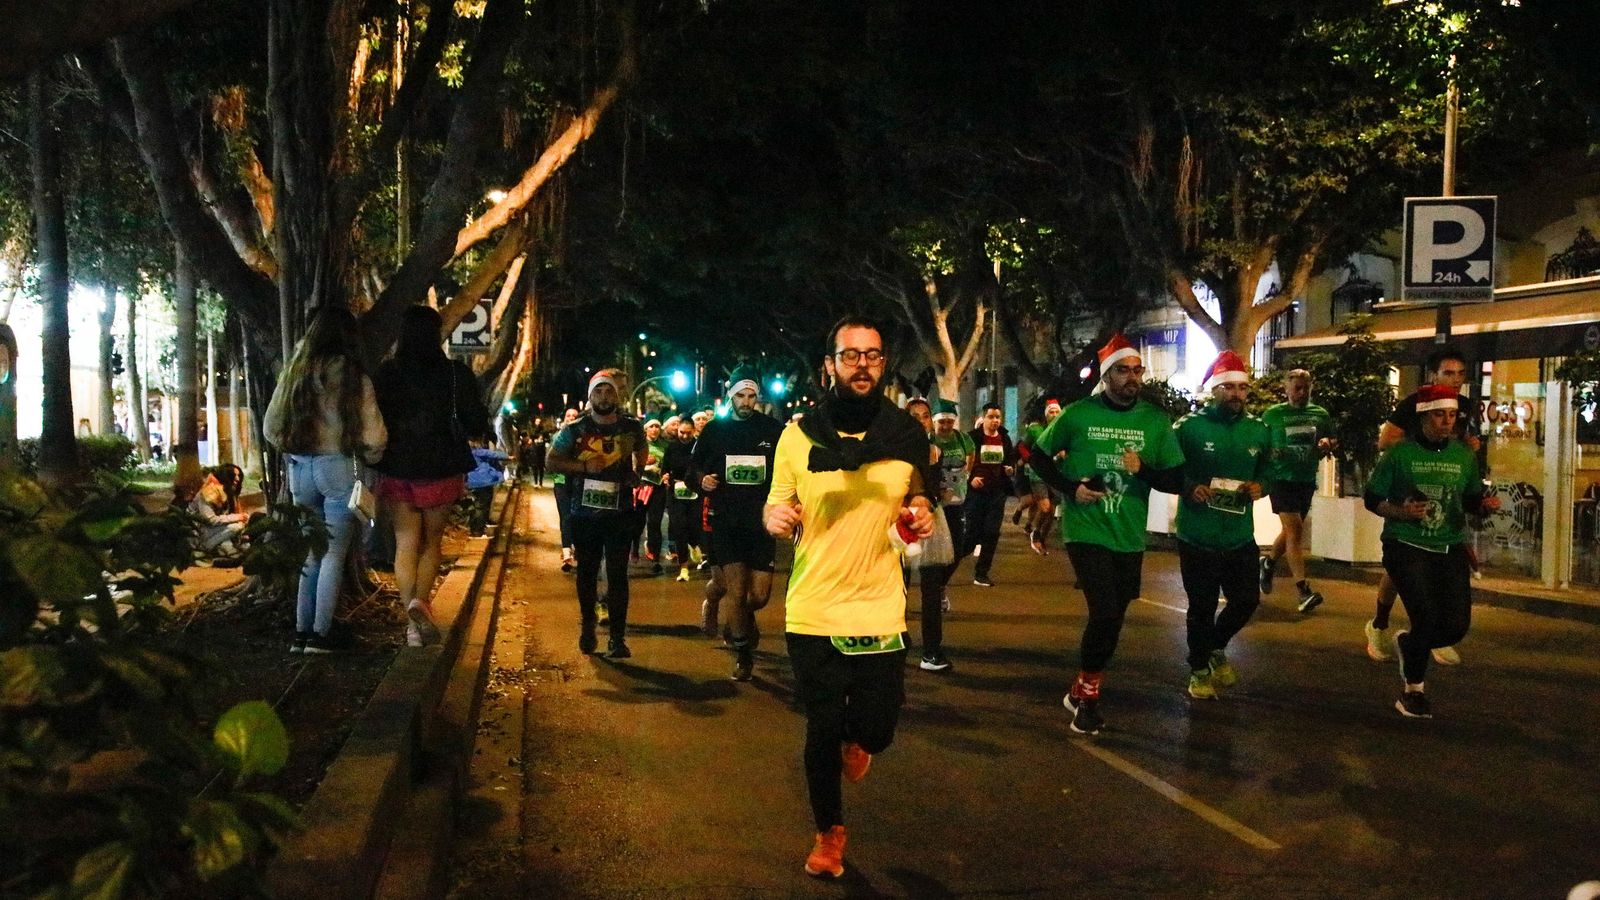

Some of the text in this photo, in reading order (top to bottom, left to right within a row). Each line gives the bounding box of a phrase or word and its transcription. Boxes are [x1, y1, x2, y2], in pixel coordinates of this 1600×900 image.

[1411, 205, 1486, 284] P
[1434, 271, 1462, 283] 24h
[1114, 428, 1144, 436] SILVESTRE
[733, 469, 758, 480] 675
